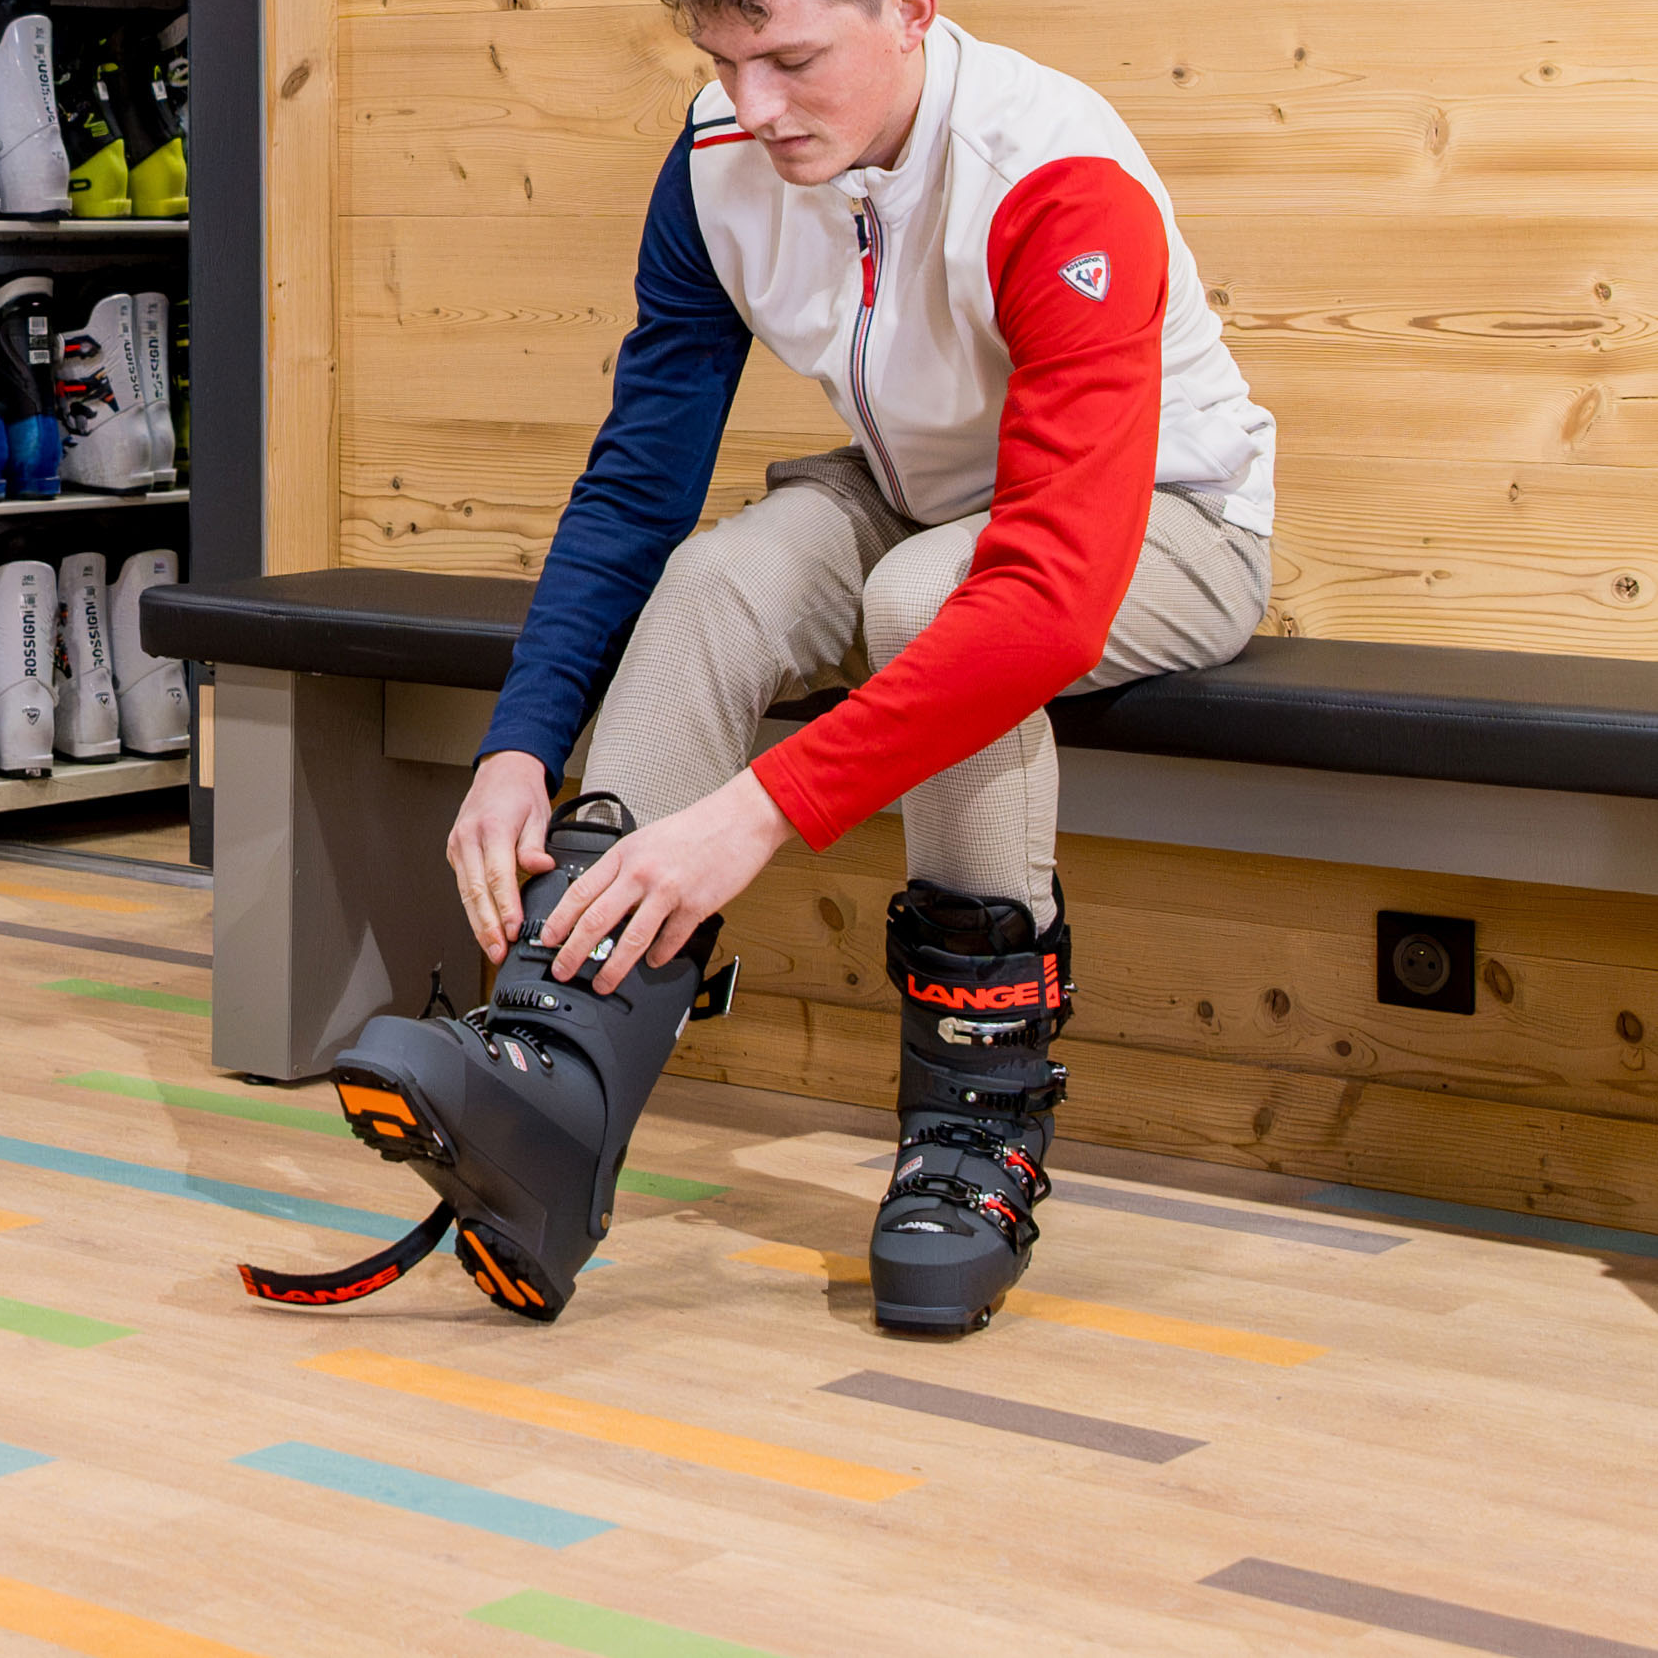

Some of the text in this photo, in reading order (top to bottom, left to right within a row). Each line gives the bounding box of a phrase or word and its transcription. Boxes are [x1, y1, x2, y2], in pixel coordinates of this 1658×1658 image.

[1065, 256, 1103, 273] ROSSIGNOL
[22, 609, 37, 678] ROSSIGN
[908, 963, 1040, 1010] LANGE
[897, 1221, 944, 1233] LANGE
[260, 1263, 401, 1305] LANGE
